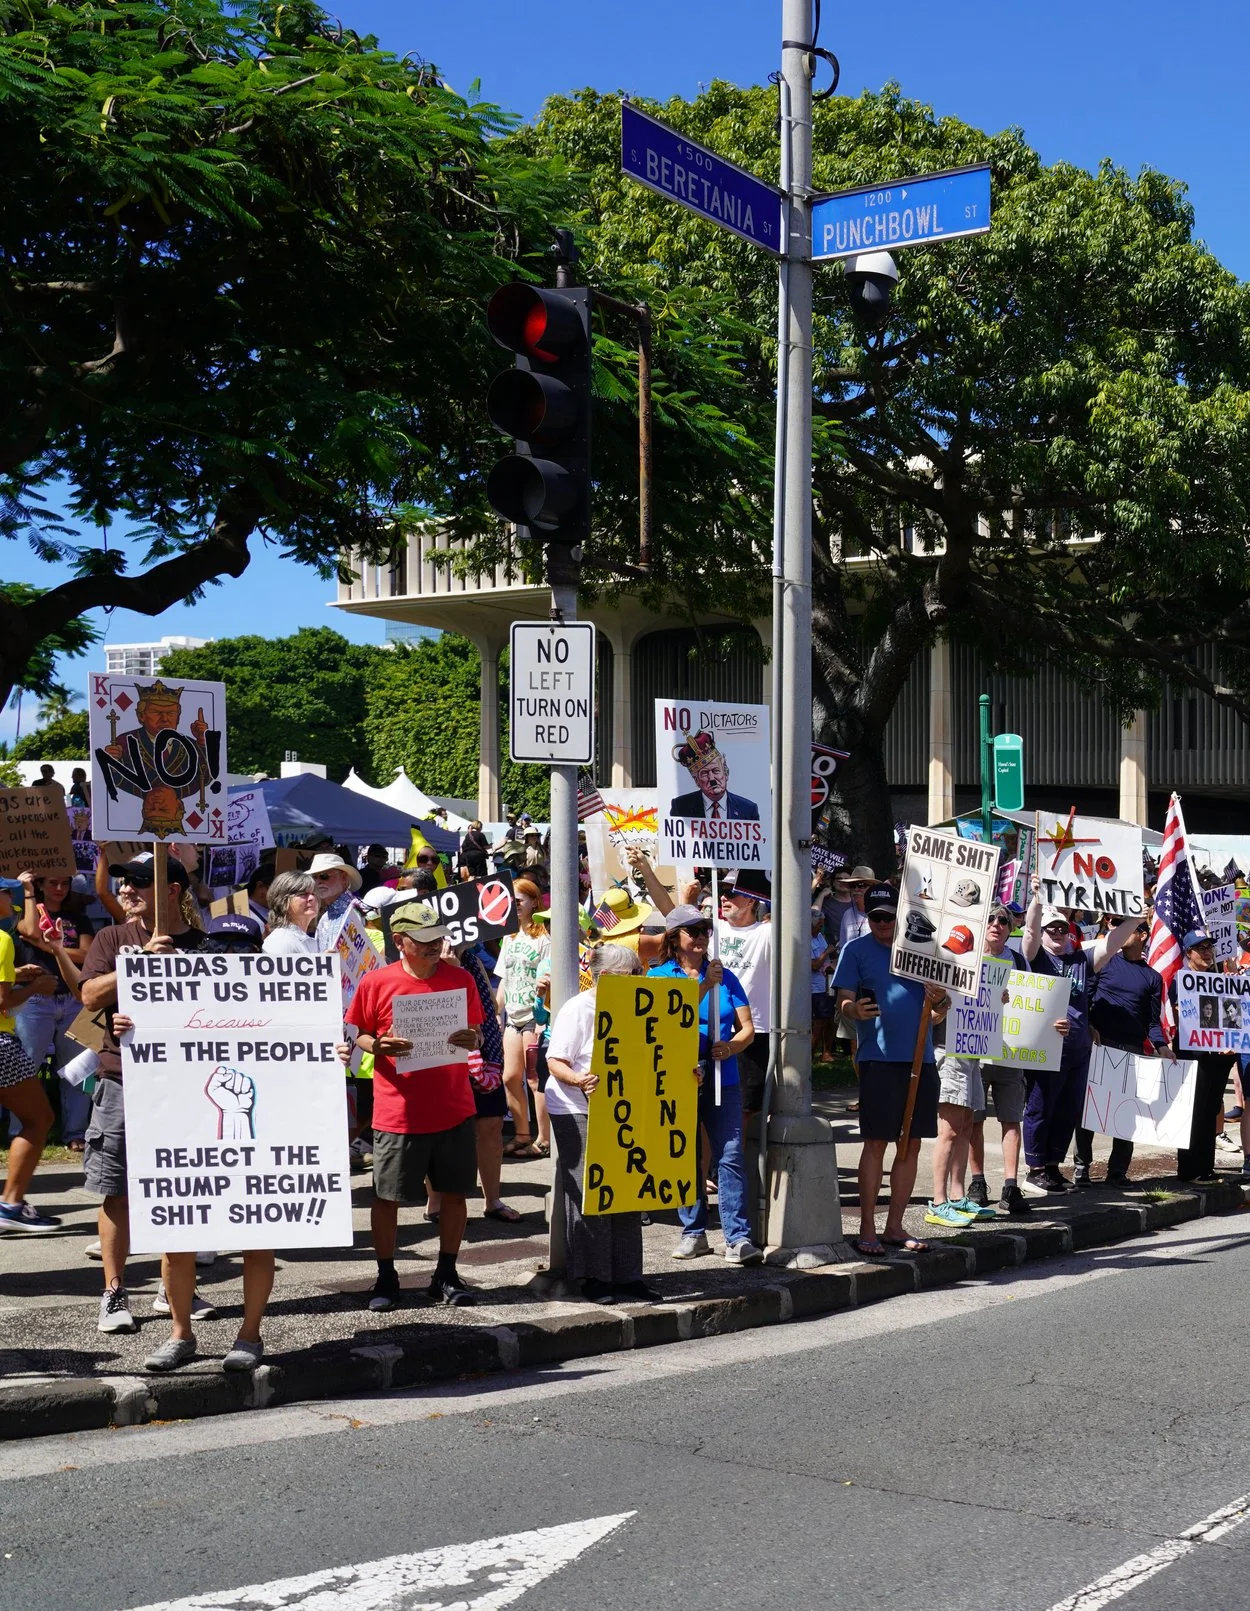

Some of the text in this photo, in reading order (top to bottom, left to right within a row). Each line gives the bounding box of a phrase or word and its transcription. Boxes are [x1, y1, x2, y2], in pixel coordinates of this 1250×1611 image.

[685, 147, 713, 172] 500
[646, 147, 755, 236] BERETANIA
[763, 221, 772, 236] ST
[864, 191, 891, 207] 1200
[823, 203, 978, 252] PUNCHBOWL ST
[537, 638, 569, 664] NO
[93, 676, 110, 696] K
[529, 671, 574, 690] LEFT
[516, 698, 588, 718] TURN ON
[664, 707, 758, 731] NO DICTATORS
[535, 725, 569, 744] RED
[95, 727, 222, 803] NO!
[25, 795, 52, 806] are
[7, 812, 60, 824] expensive
[10, 830, 49, 841] all the
[664, 818, 767, 844] NO FASCISTS,
[41, 845, 59, 856] are
[671, 840, 761, 862] IN AMERICA
[811, 845, 845, 864] HATE WILL
[911, 833, 994, 872] SAME SHIT
[17, 857, 68, 870] CONGRESS
[1073, 852, 1115, 879] NO
[422, 891, 459, 916] NO
[1042, 877, 1143, 915] TYRANTS
[1221, 900, 1234, 913] NOT
[1210, 925, 1231, 940] TEIN
[1216, 940, 1232, 957] LES
[126, 956, 228, 978] MEIDAS
[239, 956, 334, 978] TOUCH
[894, 949, 952, 984] DIFFERENT
[952, 964, 976, 991] HAT
[987, 965, 1007, 986] LAW
[1008, 971, 1056, 991] CRACY
[131, 981, 201, 1004] SENT
[214, 982, 248, 1001] US
[259, 981, 328, 1002] HERE
[414, 996, 455, 1006] DEMOCRACY
[1012, 995, 1044, 1012] ALL
[184, 1008, 272, 1029] because
[412, 1014, 458, 1022] PRESERVATION
[956, 1008, 999, 1032] TYRANNY
[129, 1042, 335, 1063] WE THE PEOPLE
[955, 1032, 989, 1055] BEGINS
[1002, 1044, 1047, 1063] ATORS
[155, 1145, 320, 1168] REJECT THE
[138, 1173, 342, 1198] TRUMP REGIME
[151, 1197, 327, 1226] SHIT SHOW!!
